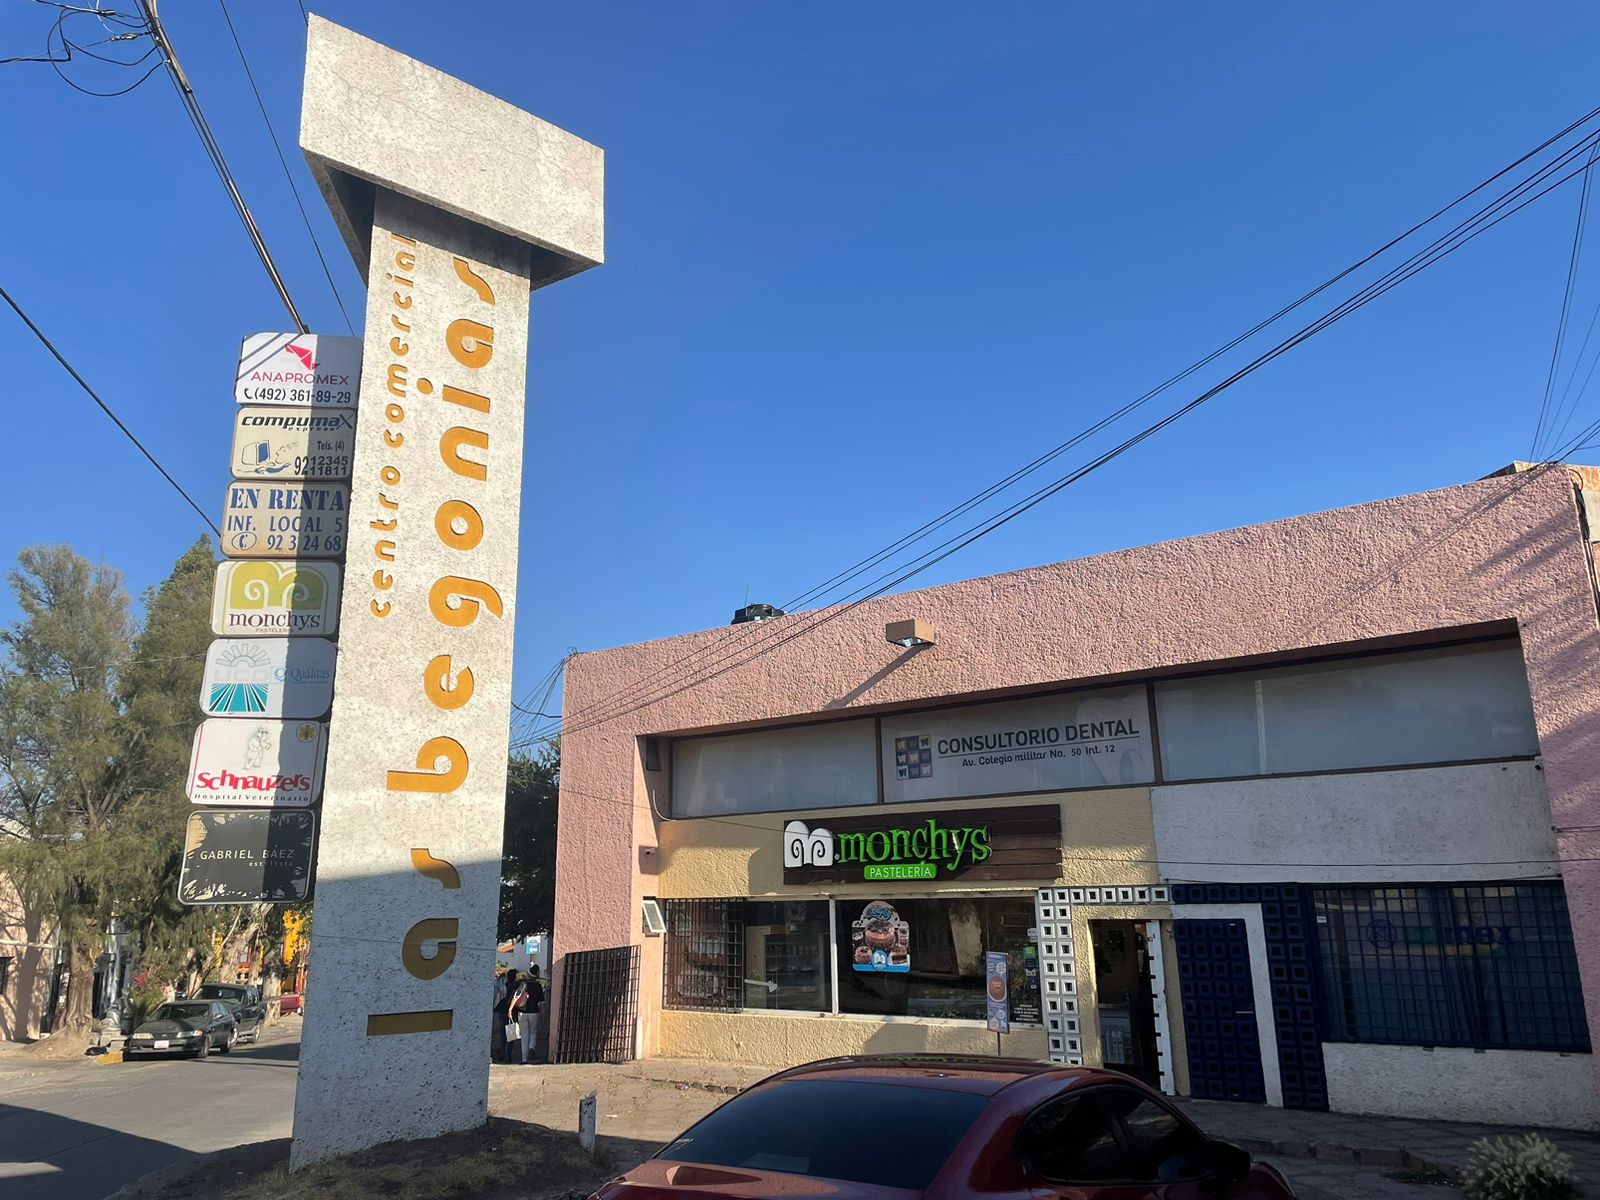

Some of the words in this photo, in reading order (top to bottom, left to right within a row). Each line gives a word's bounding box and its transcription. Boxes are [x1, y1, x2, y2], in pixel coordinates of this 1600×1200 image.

[383, 231, 417, 449] comercial
[250, 371, 350, 386] ANAPROMEX
[254, 387, 287, 401] (492)
[289, 388, 351, 404] 361-89-29
[316, 440, 334, 451] Tels.
[229, 487, 261, 509] EN
[267, 488, 345, 511] RENTA
[227, 515, 257, 532] INF.
[269, 515, 323, 533] LOCAL
[334, 521, 343, 532] 5
[385, 256, 504, 794] begonias
[267, 534, 284, 550] 92
[302, 535, 319, 551] 24
[324, 536, 342, 551] 68
[370, 464, 401, 619] centro
[228, 610, 321, 630] monchys
[937, 726, 1060, 755] CONSULTORIO
[1065, 718, 1140, 742] DENTAL
[962, 756, 977, 767] Av.
[978, 754, 1013, 767] Colegio
[1050, 749, 1066, 759] No.
[1071, 747, 1082, 757] 50
[1104, 744, 1116, 753] 12
[196, 769, 311, 792] Schnauzers
[194, 793, 242, 801] Hospital
[200, 849, 254, 860] GABRIEL
[837, 818, 992, 871] monchys
[869, 862, 933, 879] PASTELERÍA
[366, 848, 462, 1037] las
